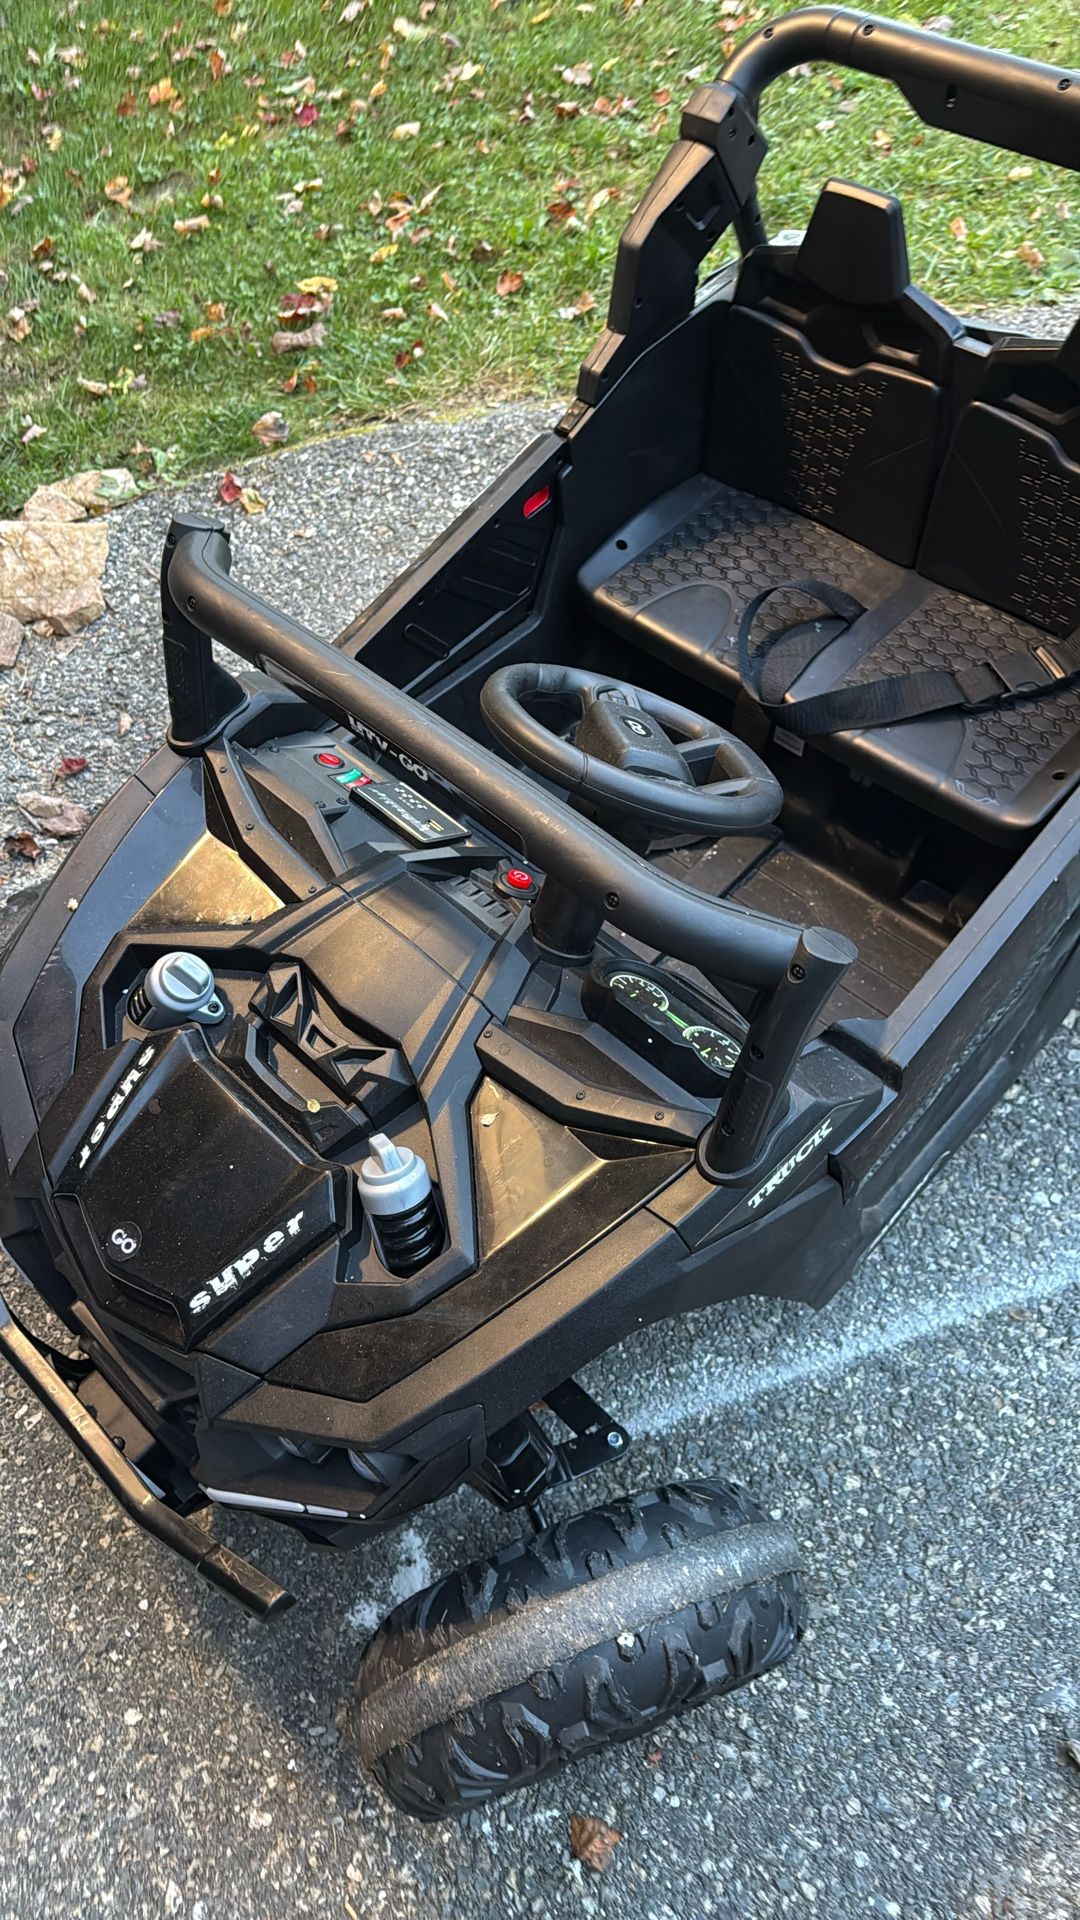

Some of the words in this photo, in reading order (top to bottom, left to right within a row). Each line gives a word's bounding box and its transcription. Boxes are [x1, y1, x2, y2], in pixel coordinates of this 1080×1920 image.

[79, 1045, 154, 1169] super
[748, 1118, 833, 1209] TRUCK
[111, 1228, 137, 1254] GO
[189, 1211, 304, 1315] super
